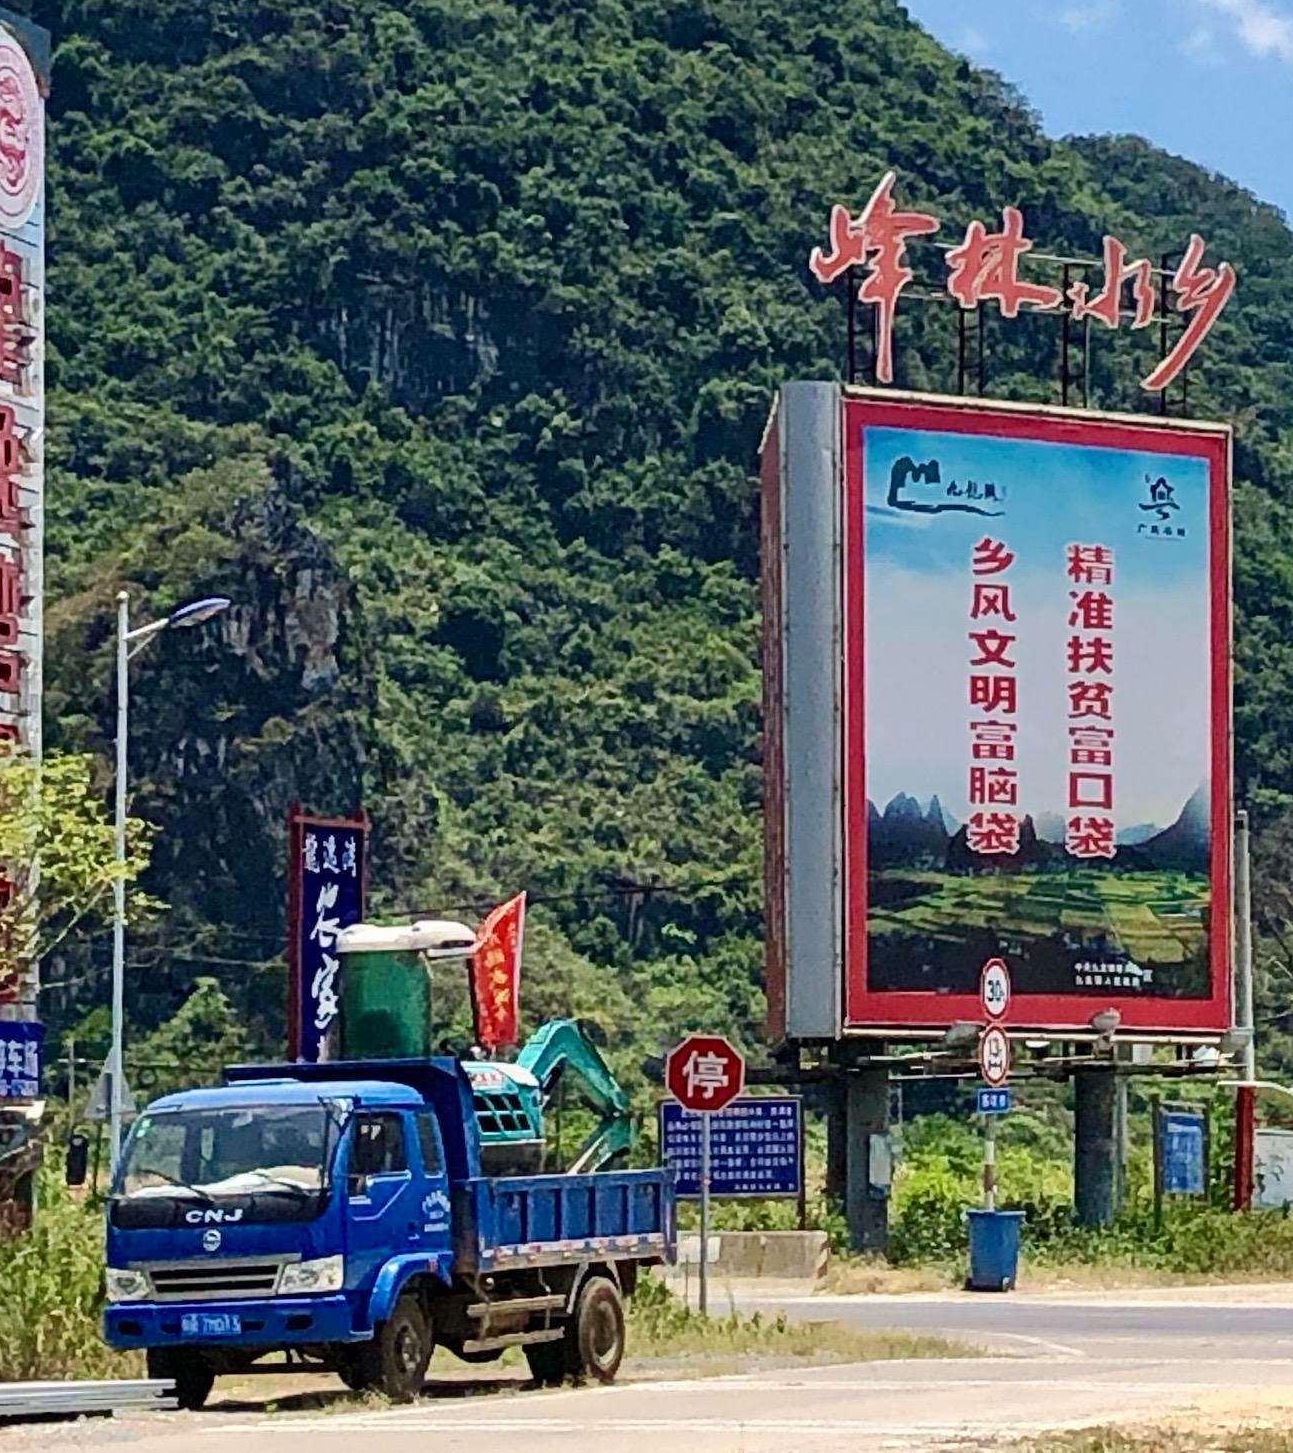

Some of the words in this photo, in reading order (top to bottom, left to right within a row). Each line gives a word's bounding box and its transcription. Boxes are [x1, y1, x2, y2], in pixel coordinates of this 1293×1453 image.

[809, 170, 1237, 391] 峰林水乡
[967, 536, 1019, 856] 乡风文明富脑袋
[1065, 543, 1116, 859] 精准扶贫富口袋
[682, 1050, 729, 1099] 停
[185, 1208, 244, 1223] CNJ
